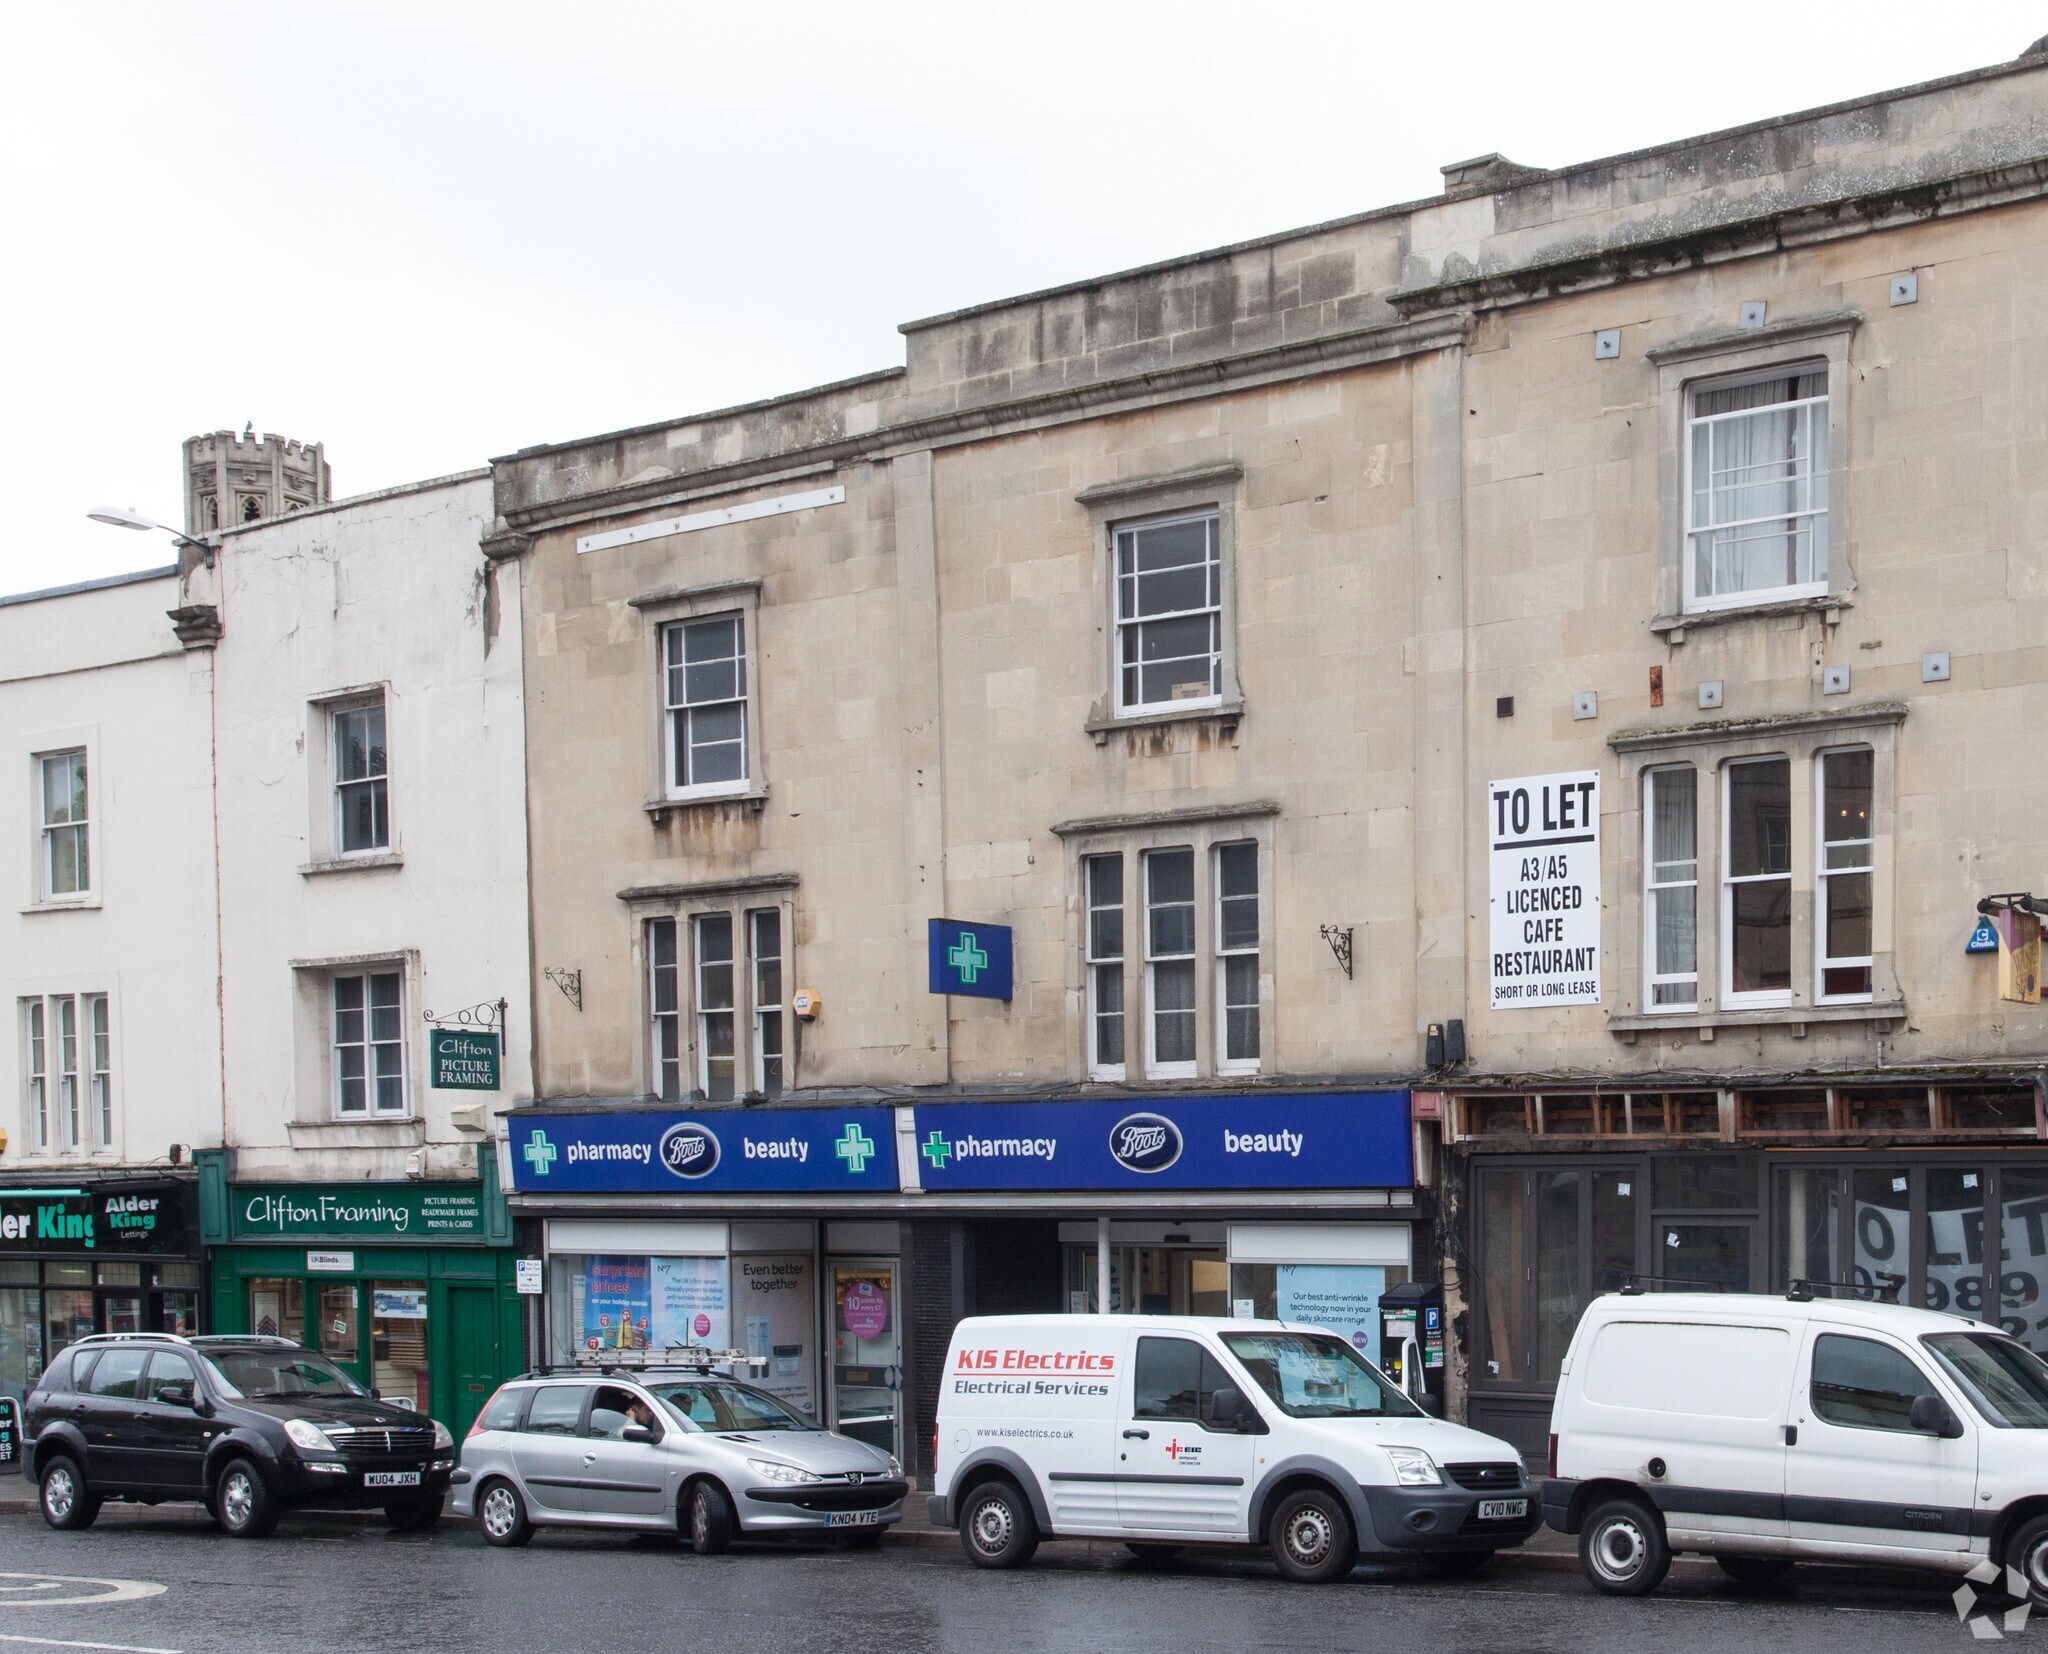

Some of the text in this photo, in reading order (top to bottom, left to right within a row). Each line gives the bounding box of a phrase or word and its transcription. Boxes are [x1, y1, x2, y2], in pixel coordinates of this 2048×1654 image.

[1494, 782, 1595, 836] TO LET
[1520, 855, 1568, 883] A3/A5
[1507, 885, 1582, 914] LICENCED
[1524, 918, 1563, 944] CAFE
[1971, 940, 1995, 948] Chubb
[1494, 947, 1595, 977] RESTAURANT
[1495, 981, 1596, 999] SHORT OR LONG LEASE
[439, 1039, 492, 1059] Clifton
[441, 1060, 490, 1072] PICTURE
[440, 1072, 492, 1084] FRAMING
[567, 1136, 808, 1164] pharmacy Boots beauty
[955, 1126, 1302, 1160] pharmacy Boots beauty
[105, 1196, 159, 1212] Alder
[246, 1195, 408, 1232] Clifton Framing
[422, 1208, 456, 1216] READYMADE
[0, 1203, 94, 1248] er King
[110, 1212, 156, 1230] King
[428, 1220, 448, 1228] PRINTS
[455, 1220, 473, 1228] CARDS
[120, 1230, 148, 1239] Lettings
[743, 1263, 804, 1275] Even better
[592, 1281, 630, 1294] prices
[751, 1278, 798, 1293] together
[847, 1296, 860, 1310] 10
[1293, 1292, 1368, 1302] Our best anti-wrinkle
[1290, 1303, 1329, 1312] technology
[1297, 1314, 1365, 1325] daily skincare range
[1429, 1311, 1436, 1326] P
[1353, 1336, 1368, 1344] NEW
[958, 1350, 1114, 1370] KIS Electrics
[954, 1381, 1109, 1396] Electrical Services
[977, 1427, 1074, 1439] www.kiselectrics.co.uk
[368, 1473, 416, 1485] WU04 JXH
[1484, 1502, 1504, 1516] CV10
[831, 1511, 877, 1525] KN04 VTE
